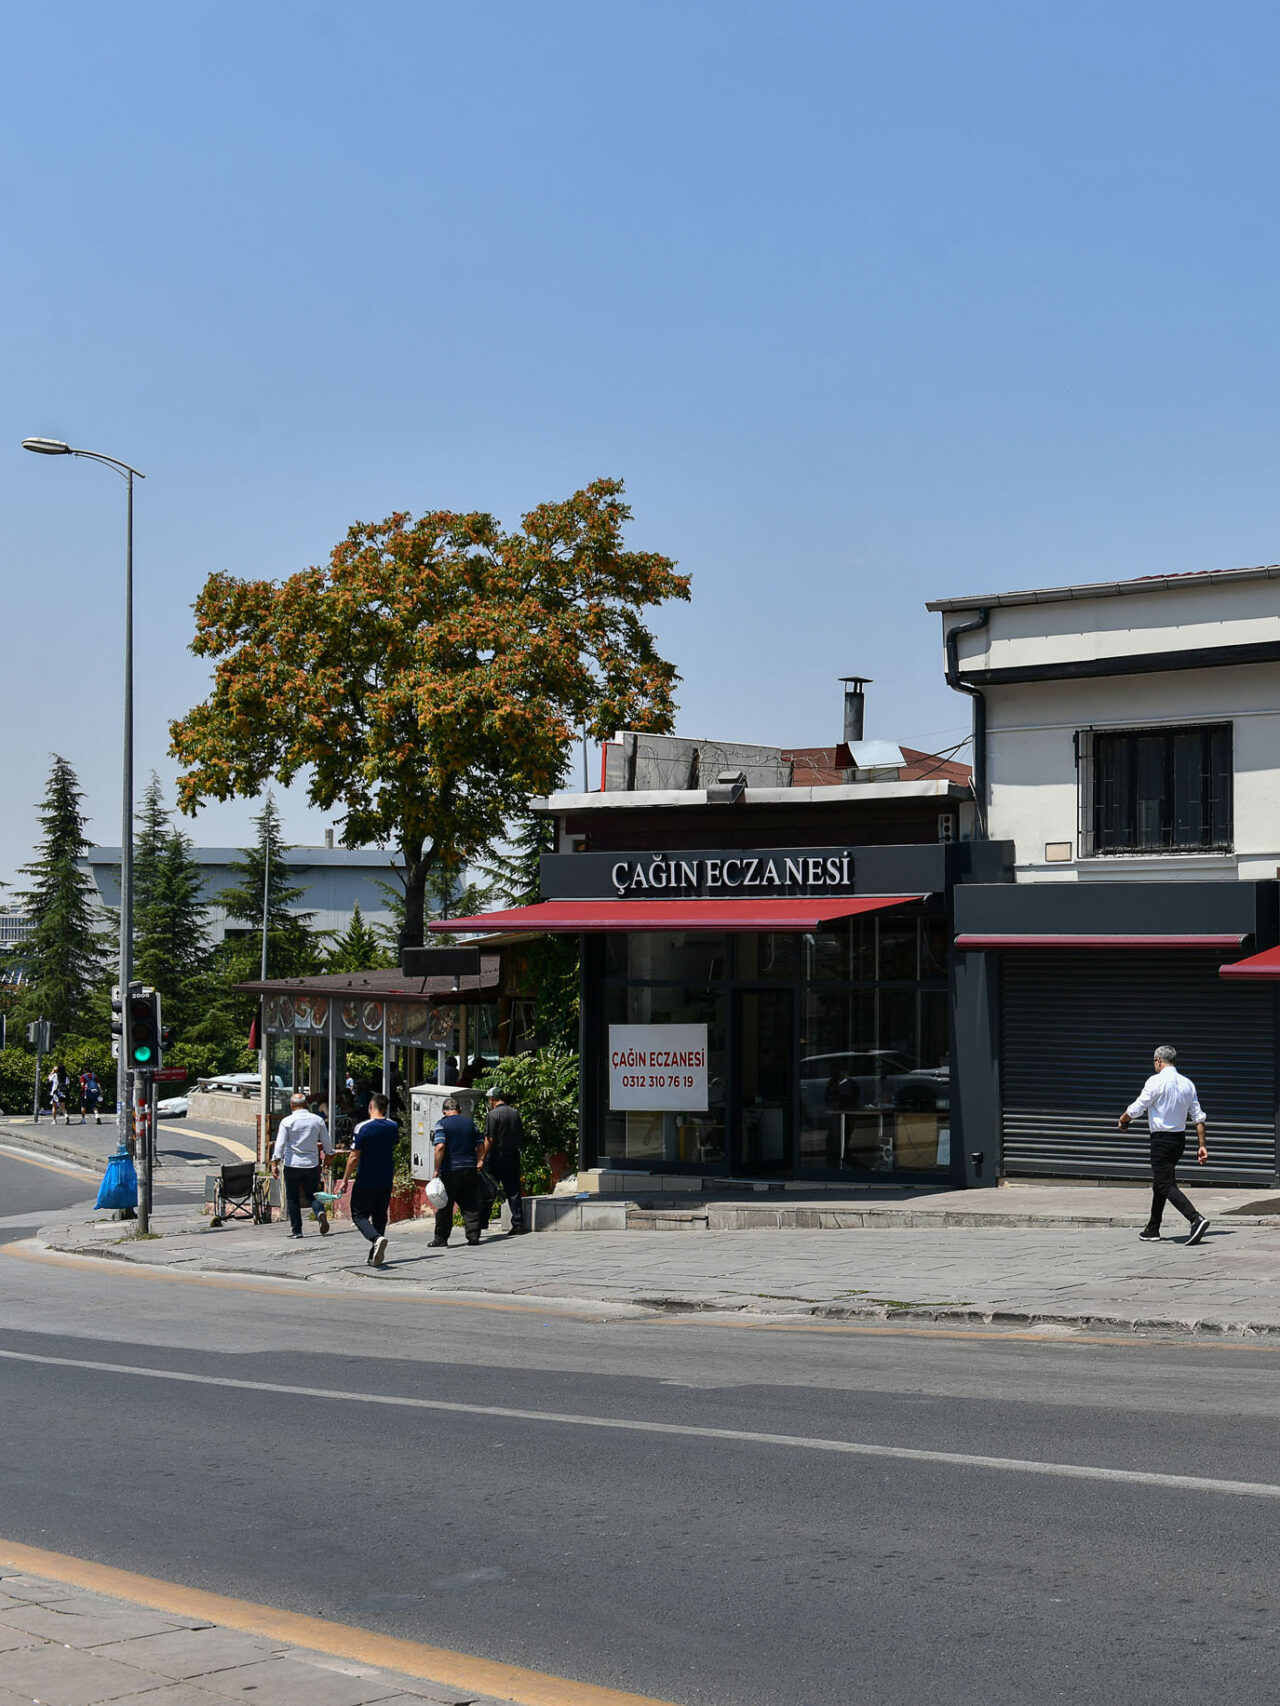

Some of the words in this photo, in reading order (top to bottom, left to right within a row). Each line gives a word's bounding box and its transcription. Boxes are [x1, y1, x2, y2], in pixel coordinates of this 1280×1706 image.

[611, 854, 699, 894] ÇAĞIN
[705, 850, 851, 886] ECZANESİ
[612, 1047, 647, 1070] ÇAĞIN
[649, 1047, 705, 1067] ECZANESİ
[622, 1075, 646, 1087] 0312
[648, 1075, 665, 1087] 310
[668, 1075, 680, 1087] 76
[683, 1075, 694, 1087] 19
